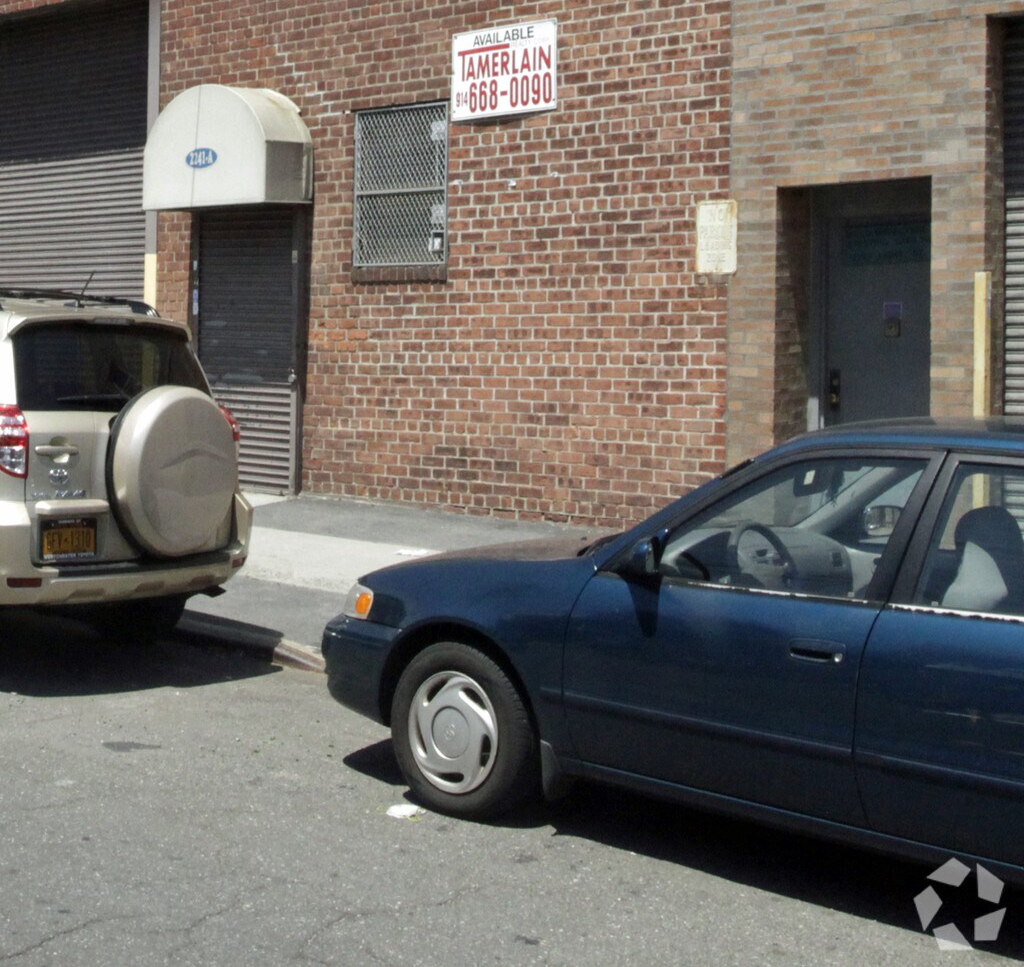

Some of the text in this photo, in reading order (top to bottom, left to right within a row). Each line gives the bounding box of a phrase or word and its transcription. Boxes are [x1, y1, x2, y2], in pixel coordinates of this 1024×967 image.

[473, 26, 534, 47] AVAILABLE
[458, 43, 551, 82] TAMERLAIN
[469, 72, 552, 113] 668-0090
